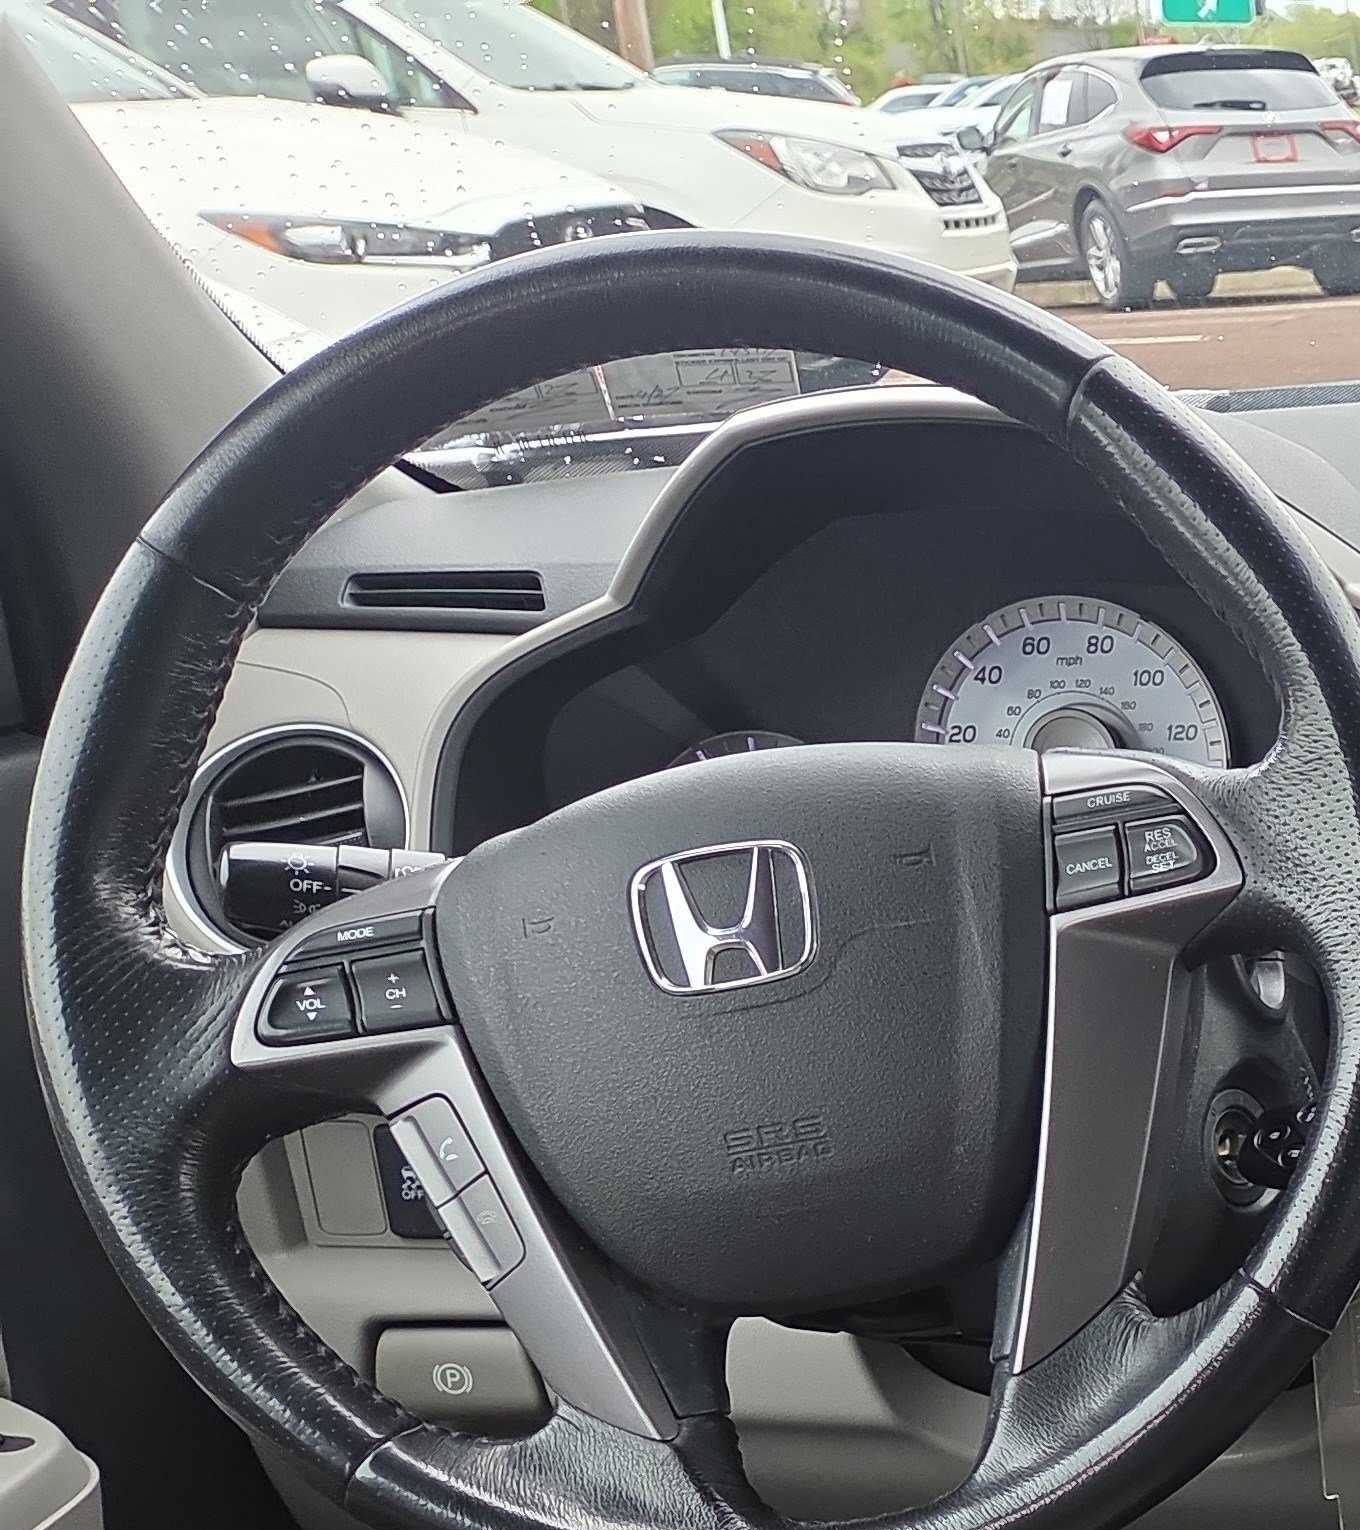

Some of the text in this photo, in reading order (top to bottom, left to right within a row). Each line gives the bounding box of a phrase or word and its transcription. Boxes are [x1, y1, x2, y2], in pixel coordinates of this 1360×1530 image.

[1022, 635, 1114, 655] 60 80
[1056, 655, 1083, 666] mph
[974, 665, 1165, 687] 40 100
[1050, 679, 1091, 689] 100 120
[949, 725, 977, 744] 20
[996, 728, 1011, 739] 40
[1168, 724, 1198, 741] 120
[1087, 791, 1131, 808] CRUISE
[1145, 827, 1172, 842] RES
[1144, 839, 1178, 853] ACCEL
[1146, 851, 1179, 865] DECEL
[1066, 857, 1113, 876] CANCEL
[1152, 861, 1175, 872] SET
[290, 878, 323, 894] OFF
[337, 926, 375, 940] MODE
[385, 987, 406, 1000] CH
[296, 998, 327, 1011] VOL
